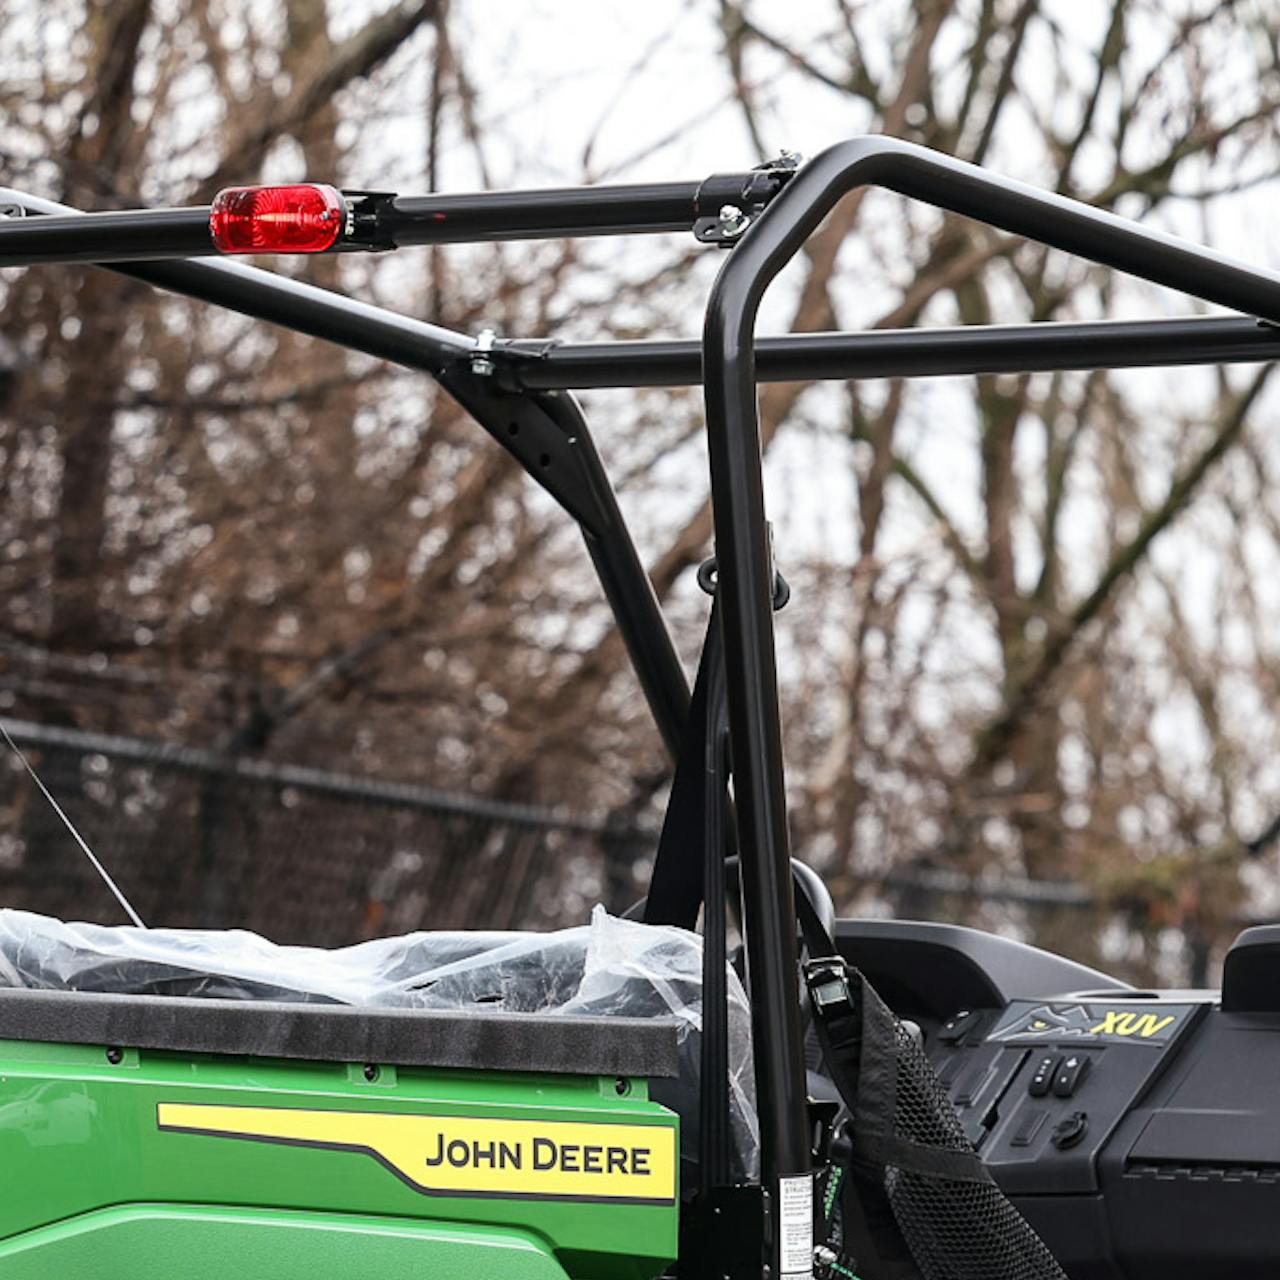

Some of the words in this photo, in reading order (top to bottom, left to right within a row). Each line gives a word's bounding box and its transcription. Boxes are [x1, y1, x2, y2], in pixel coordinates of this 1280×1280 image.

[1090, 1011, 1176, 1037] XUV
[426, 1133, 522, 1170] JOHN
[532, 1137, 651, 1175] DEERE
